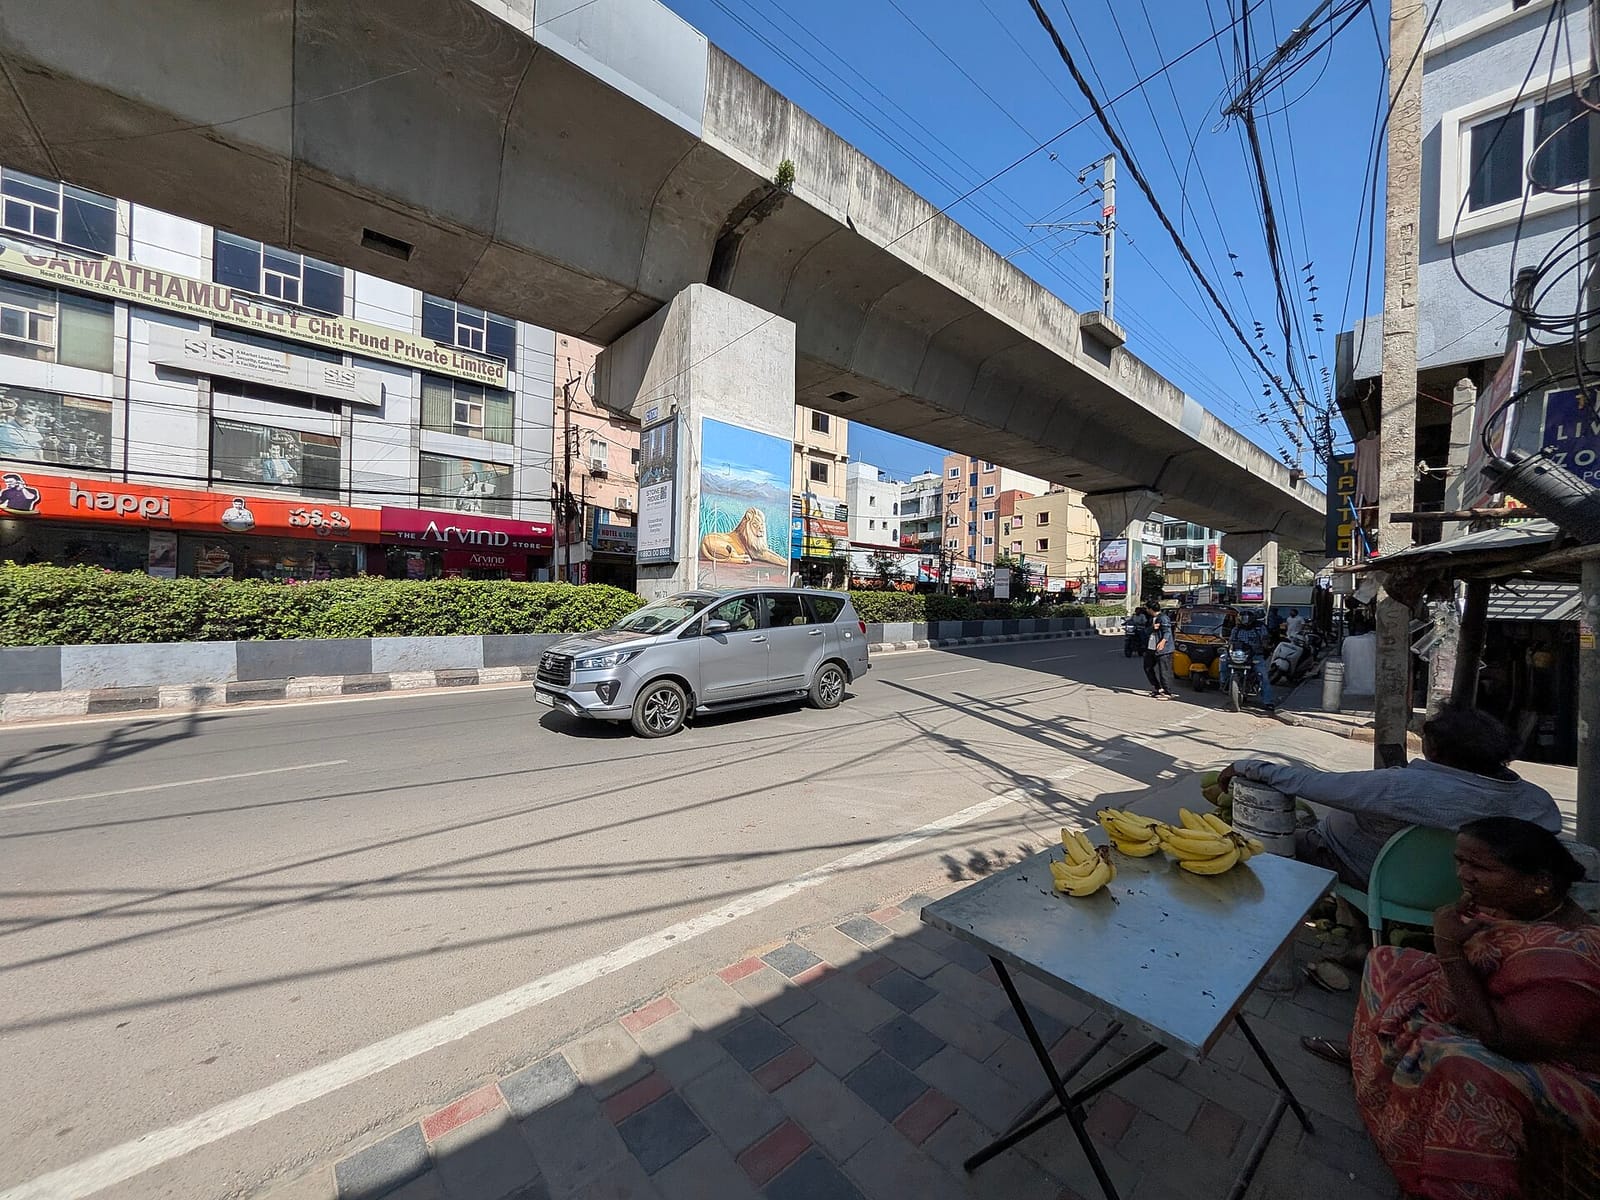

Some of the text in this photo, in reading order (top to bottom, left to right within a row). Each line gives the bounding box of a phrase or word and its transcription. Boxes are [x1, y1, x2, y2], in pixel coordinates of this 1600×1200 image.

[40, 269, 56, 279] Head
[57, 272, 75, 283] Office
[118, 288, 137, 298] Fourth
[171, 300, 187, 311] Happy
[308, 318, 345, 339] Chit
[349, 327, 389, 353] Fund
[394, 339, 448, 366] Private
[452, 353, 504, 379] Limited
[69, 481, 170, 519] happi
[397, 531, 416, 540] THE
[512, 541, 541, 549] STORE
[601, 528, 617, 537] HOTEL
